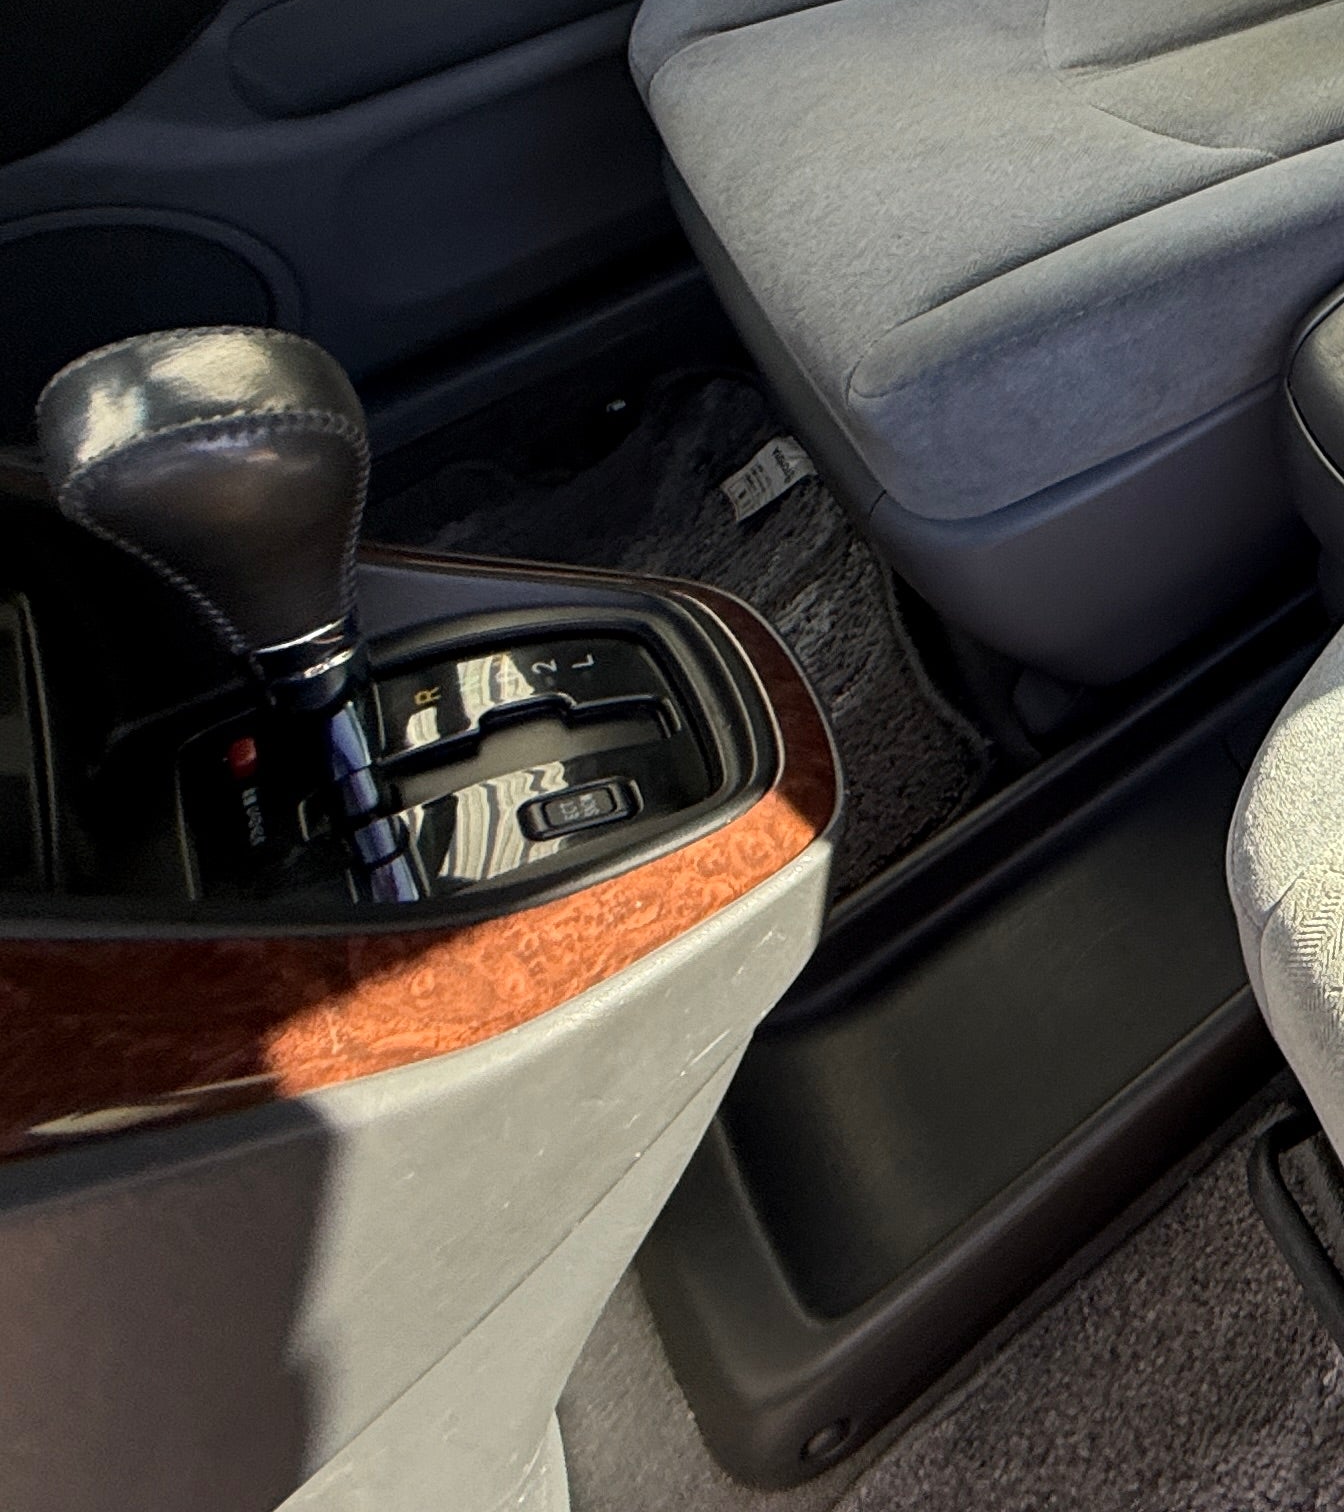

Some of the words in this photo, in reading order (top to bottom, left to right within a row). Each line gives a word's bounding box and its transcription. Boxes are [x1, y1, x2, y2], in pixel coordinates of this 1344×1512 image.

[531, 659, 557, 674] 2
[571, 653, 594, 669] L
[414, 687, 441, 705] R
